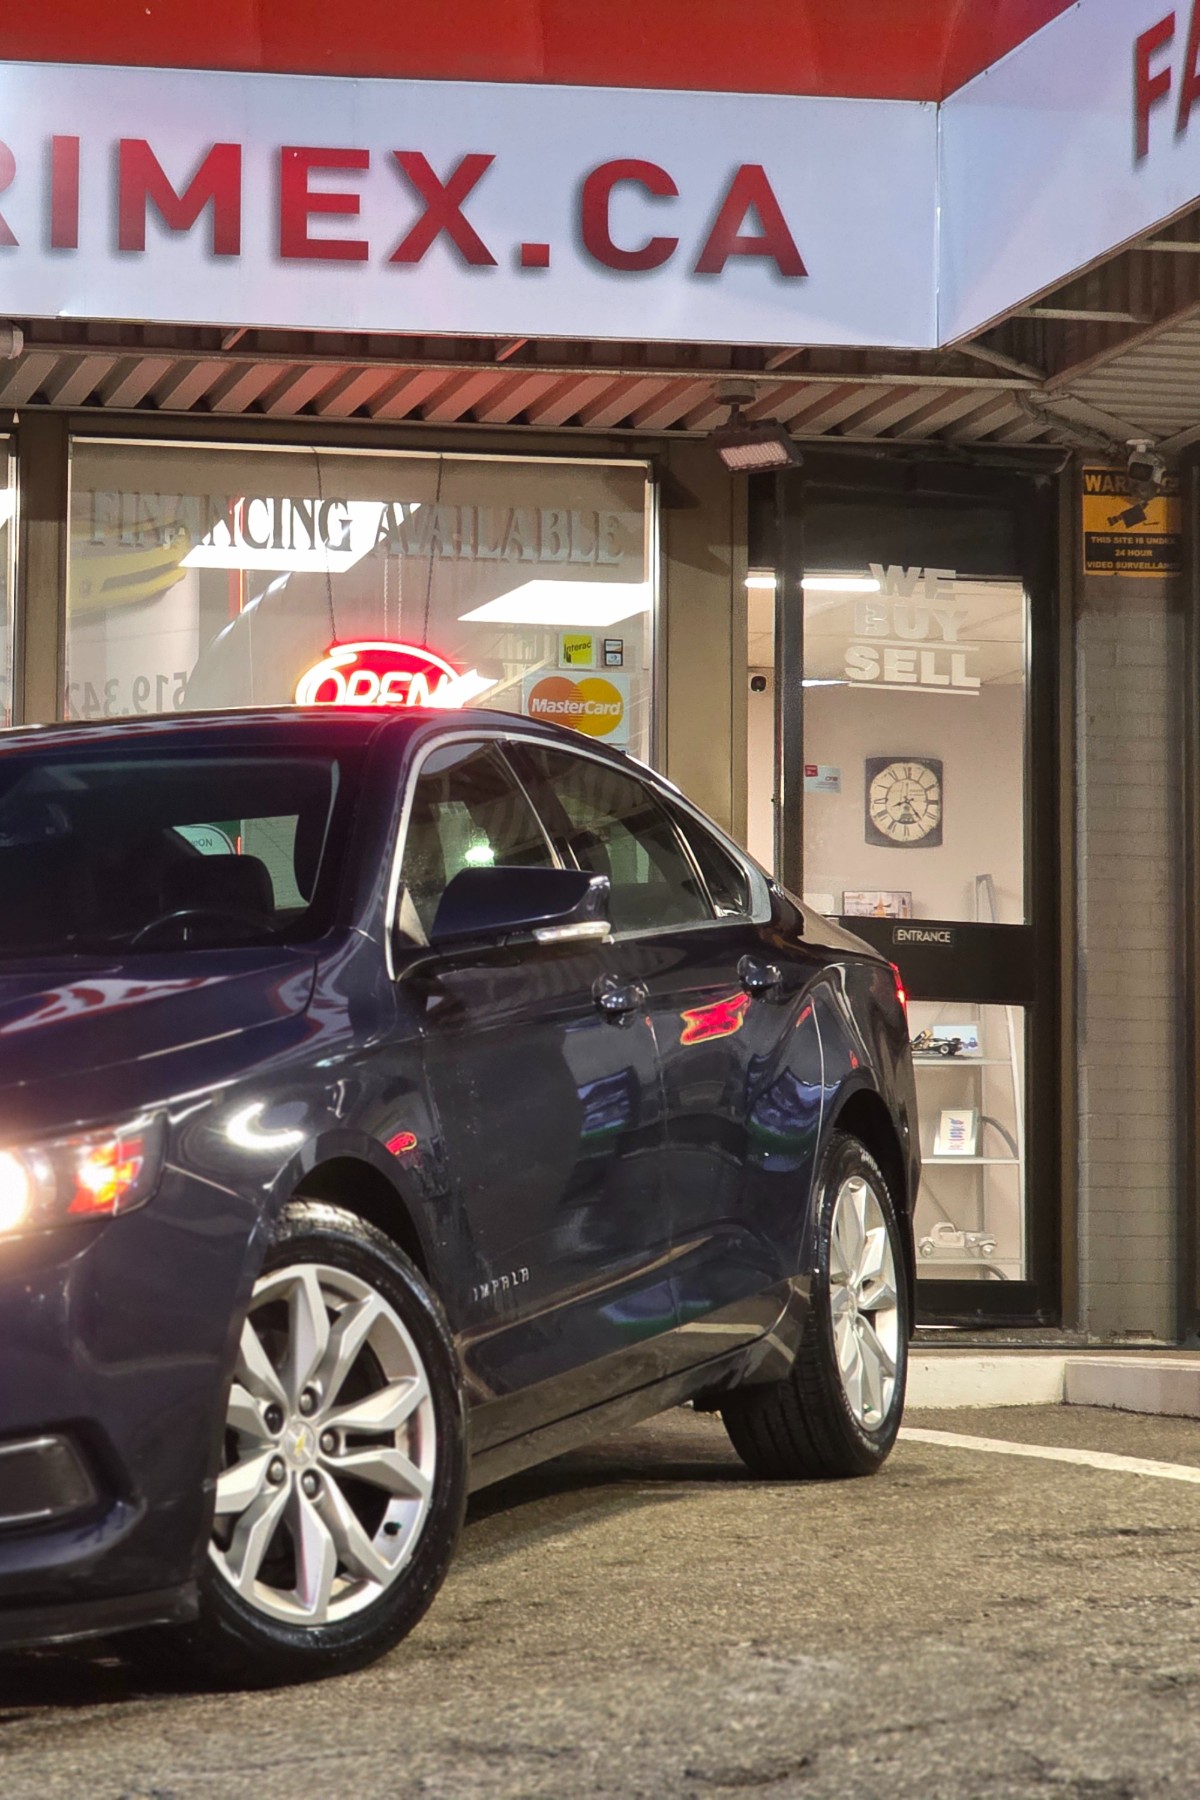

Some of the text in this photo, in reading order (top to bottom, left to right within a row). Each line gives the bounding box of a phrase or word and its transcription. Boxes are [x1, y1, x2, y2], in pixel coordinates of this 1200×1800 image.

[91, 490, 625, 564] FINANCING AVAILABLE
[1090, 536, 1112, 544] THIS
[1114, 536, 1134, 544] SITE
[1087, 561, 1180, 570] VIDEO SURVEILLAN
[1115, 549, 1153, 557] 24 HOUR
[869, 563, 957, 600] WE
[854, 601, 969, 642] BUY
[564, 641, 592, 654] Interac
[844, 645, 982, 688] SELL
[306, 669, 452, 706] OPEN
[531, 698, 621, 715] MasterCard
[897, 929, 951, 943] ENTRANCE
[472, 1267, 530, 1301] IMPALA
